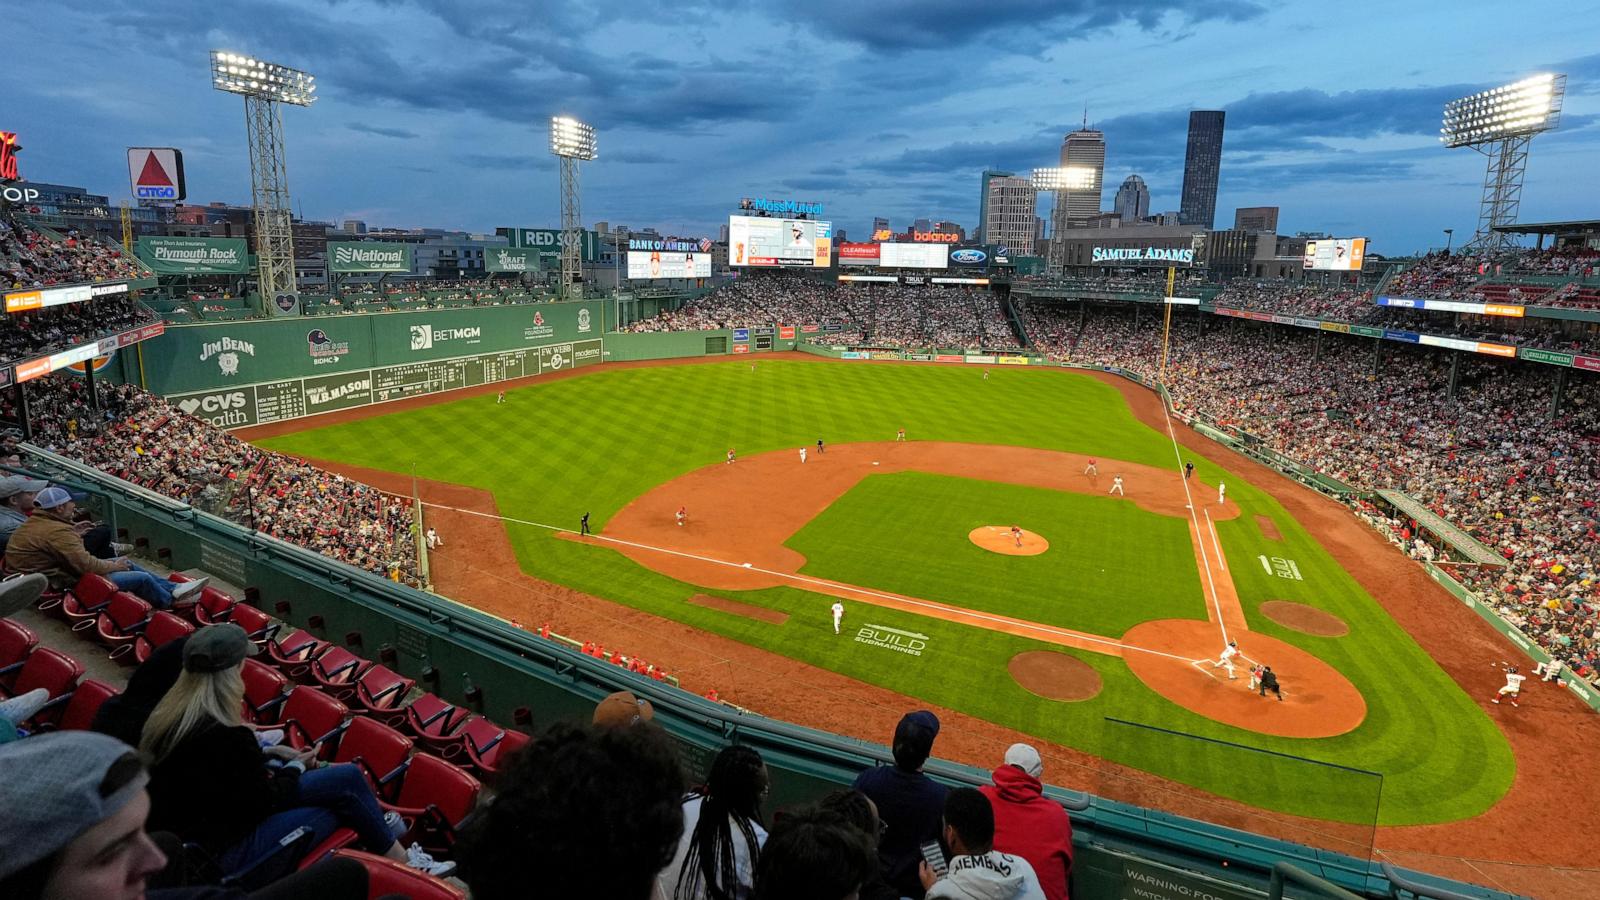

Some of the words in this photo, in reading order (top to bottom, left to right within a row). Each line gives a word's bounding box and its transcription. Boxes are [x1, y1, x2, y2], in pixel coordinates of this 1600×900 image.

[137, 187, 175, 198] CITGO
[755, 198, 822, 214] MassMutual
[525, 231, 554, 246] RED
[914, 230, 959, 242] balance
[629, 239, 653, 250] BANK
[654, 240, 665, 250] OF
[665, 241, 698, 251] AMERICA
[154, 246, 207, 260] Plymouth
[209, 248, 237, 259] Rock
[352, 249, 402, 262] National
[500, 255, 526, 265] DRAFT
[957, 253, 980, 261] Ford
[1092, 247, 1143, 262] SAMUEL
[1144, 247, 1193, 262] ADAMS
[433, 327, 480, 341] BETMGM
[200, 341, 222, 361] JIM
[222, 336, 255, 357] BEAM
[313, 356, 333, 365] BIDMC
[202, 392, 246, 412] CVS
[854, 636, 922, 656] SUBMARINES
[857, 628, 926, 650] BUILD
[1126, 869, 1192, 896] WARNING:
